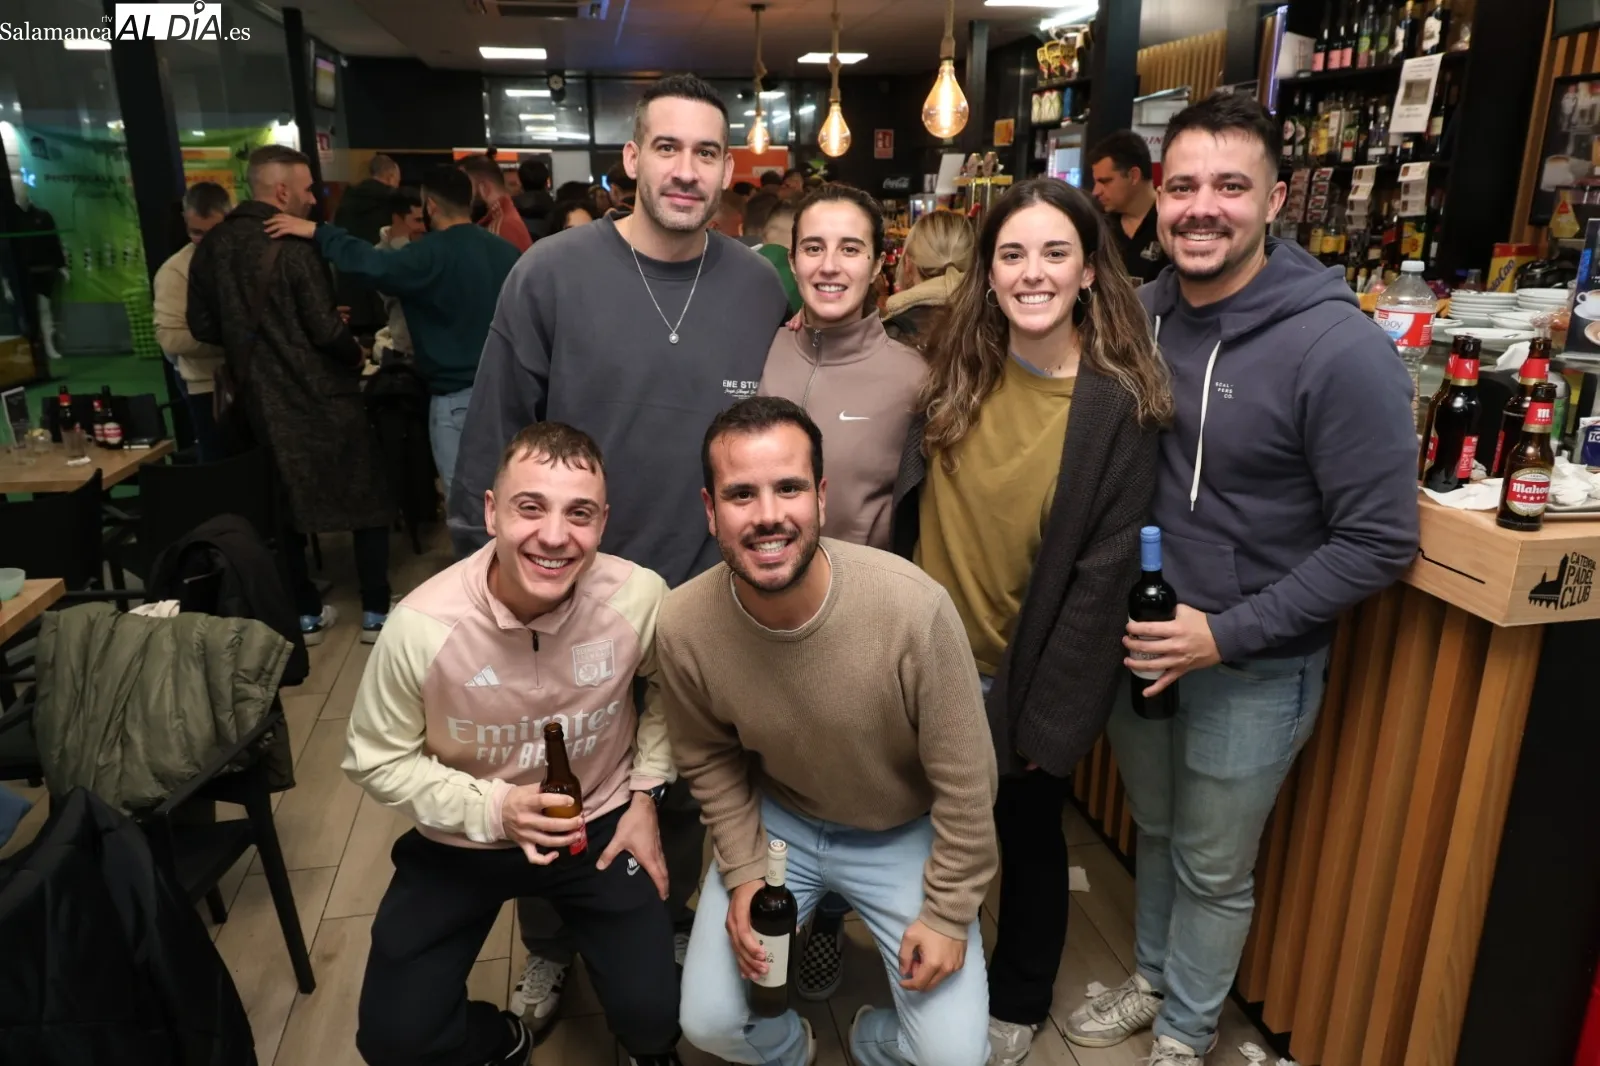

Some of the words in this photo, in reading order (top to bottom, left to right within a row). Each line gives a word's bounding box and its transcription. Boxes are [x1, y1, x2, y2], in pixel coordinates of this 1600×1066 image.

[1564, 564, 1593, 585] PADEL
[1559, 585, 1592, 610] CLUB
[476, 746, 514, 765] FLY
[518, 735, 597, 769] BETER
